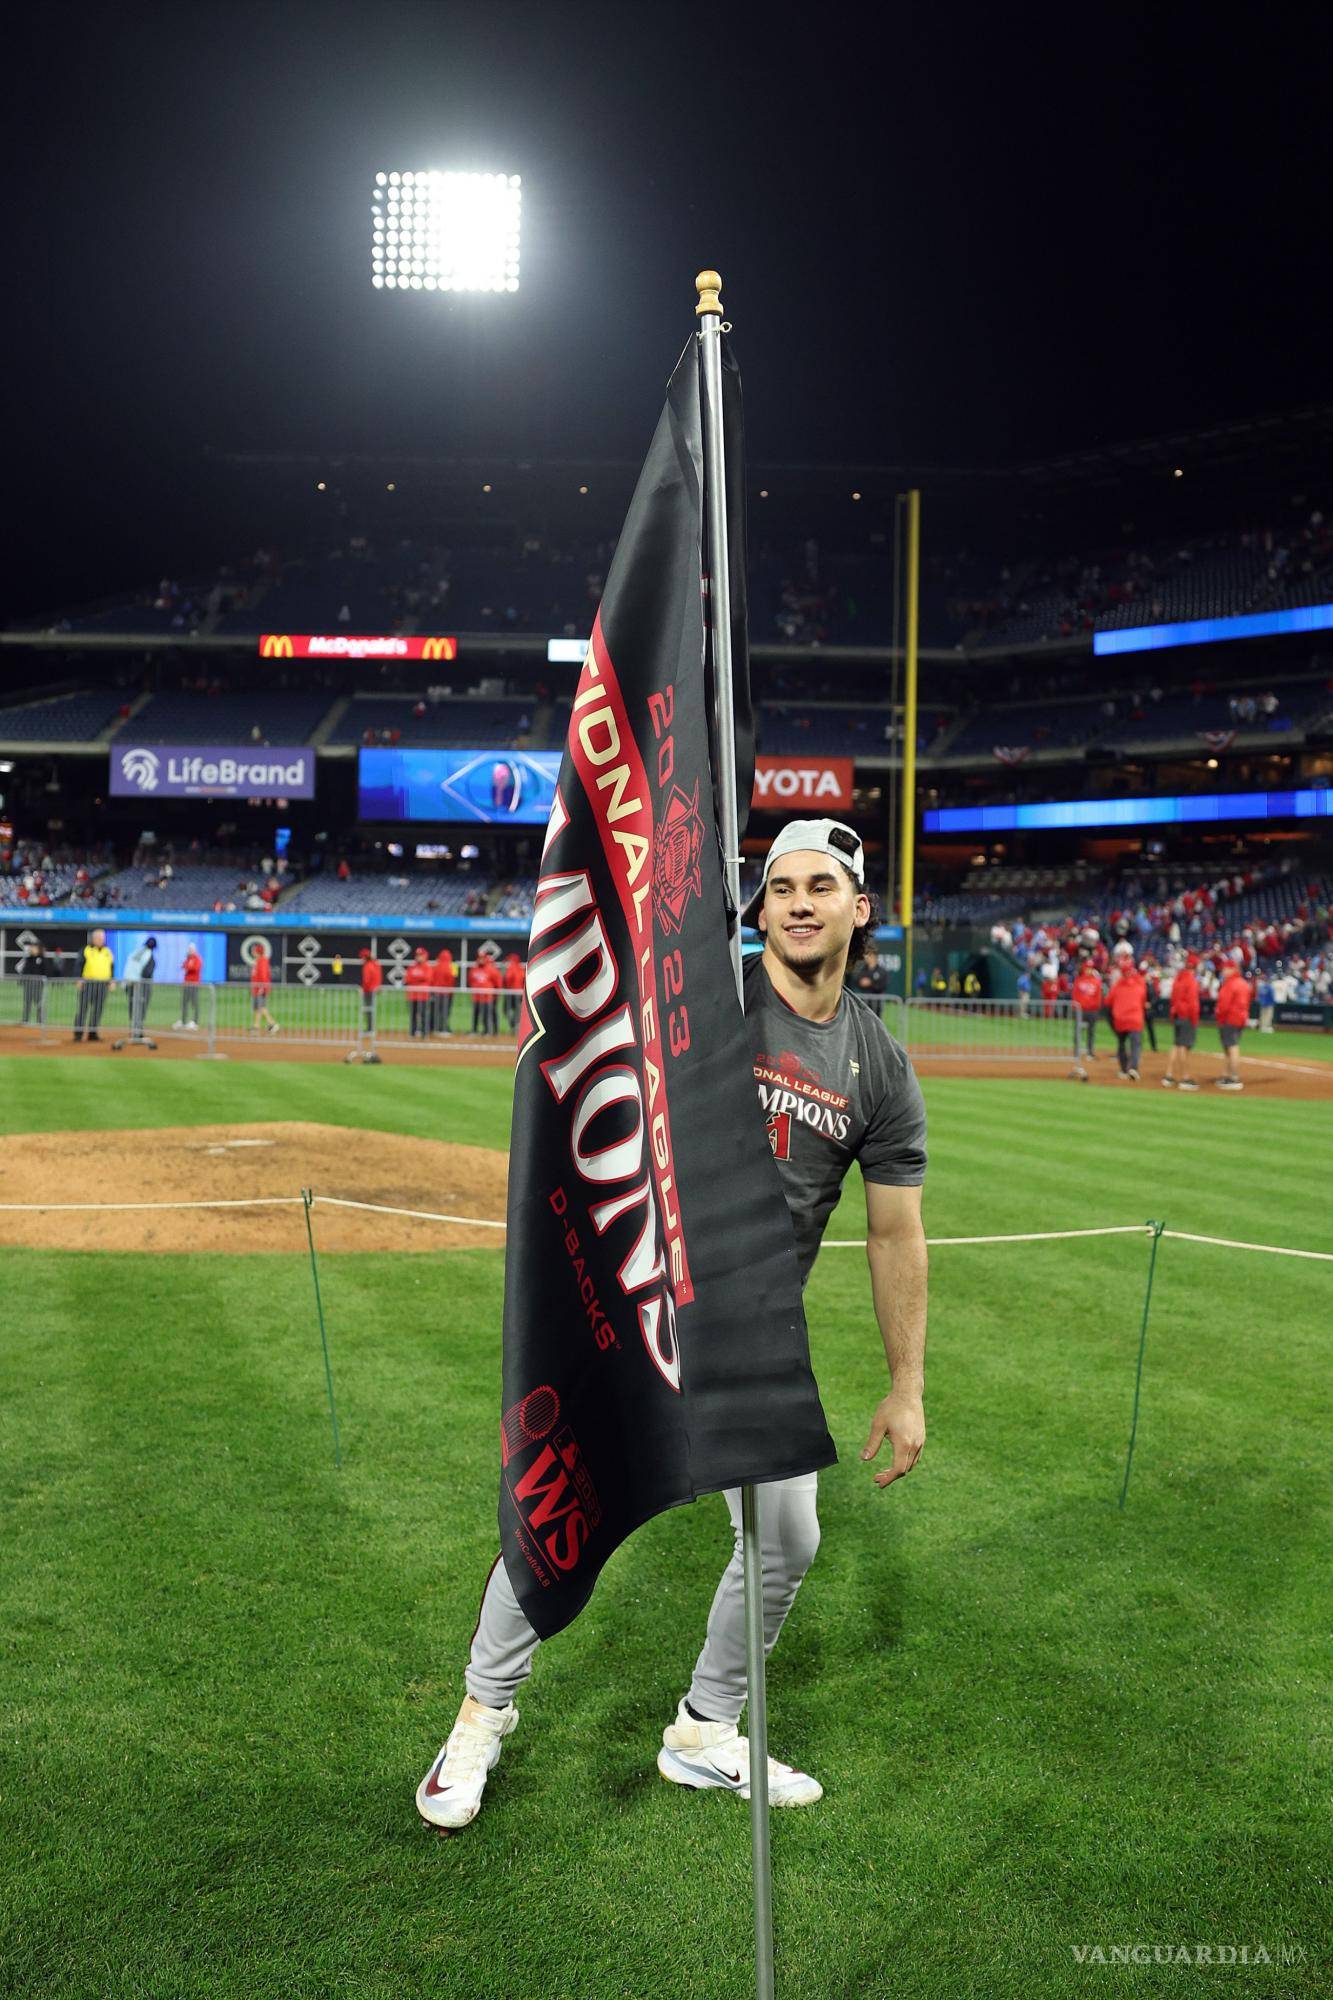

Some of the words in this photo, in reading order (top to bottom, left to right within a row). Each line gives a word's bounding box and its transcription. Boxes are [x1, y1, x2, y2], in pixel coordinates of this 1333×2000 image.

[167, 757, 305, 786] LifeBrand
[755, 768, 842, 797] YOTA
[647, 684, 674, 788] 20
[662, 948, 691, 1058] 23
[671, 830, 686, 884] NATIONAL
[640, 945, 685, 1288] LEAGUE
[758, 1084, 852, 1140] MPIONS
[794, 1080, 849, 1109] LEAGUE
[549, 1186, 616, 1351] D-BACKS
[513, 1443, 590, 1571] WS
